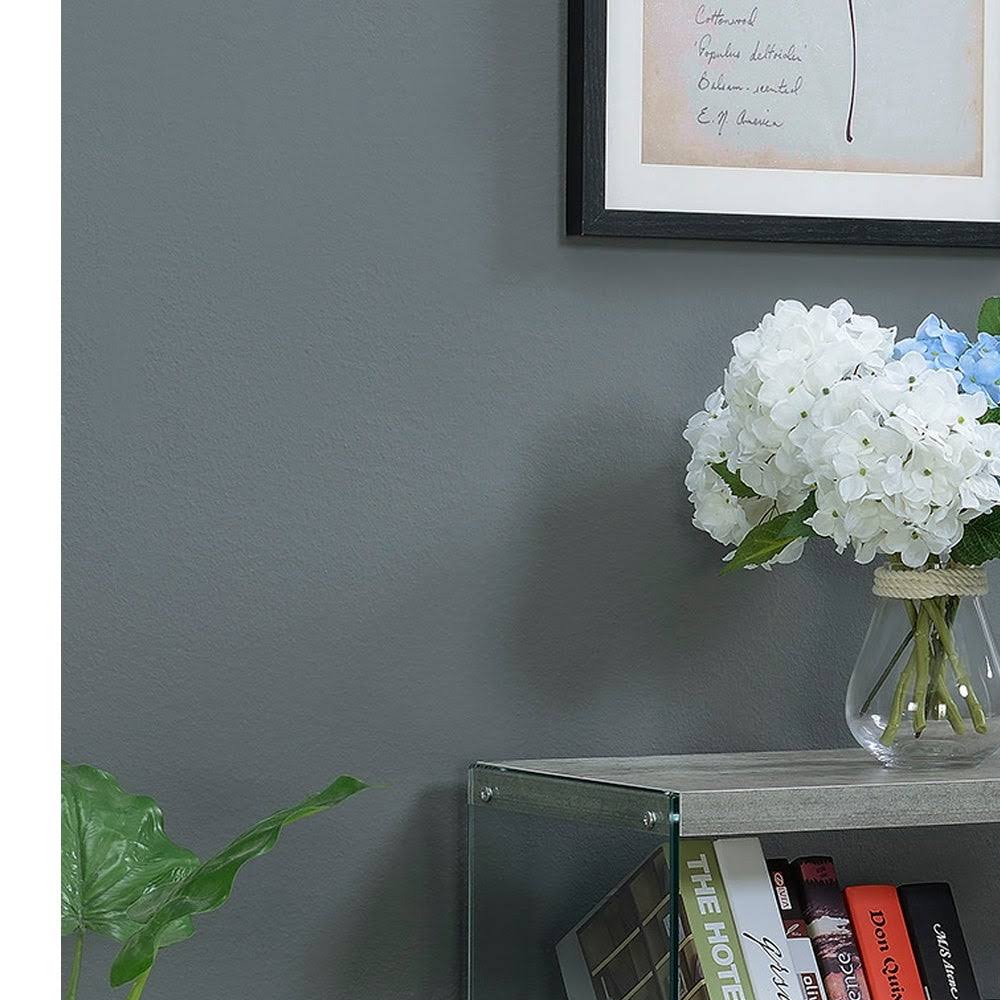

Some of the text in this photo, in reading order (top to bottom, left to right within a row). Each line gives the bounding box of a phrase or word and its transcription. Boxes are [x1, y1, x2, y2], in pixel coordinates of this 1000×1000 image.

[736, 108, 784, 128] America
[686, 853, 721, 915] THE
[869, 910, 889, 953] Don
